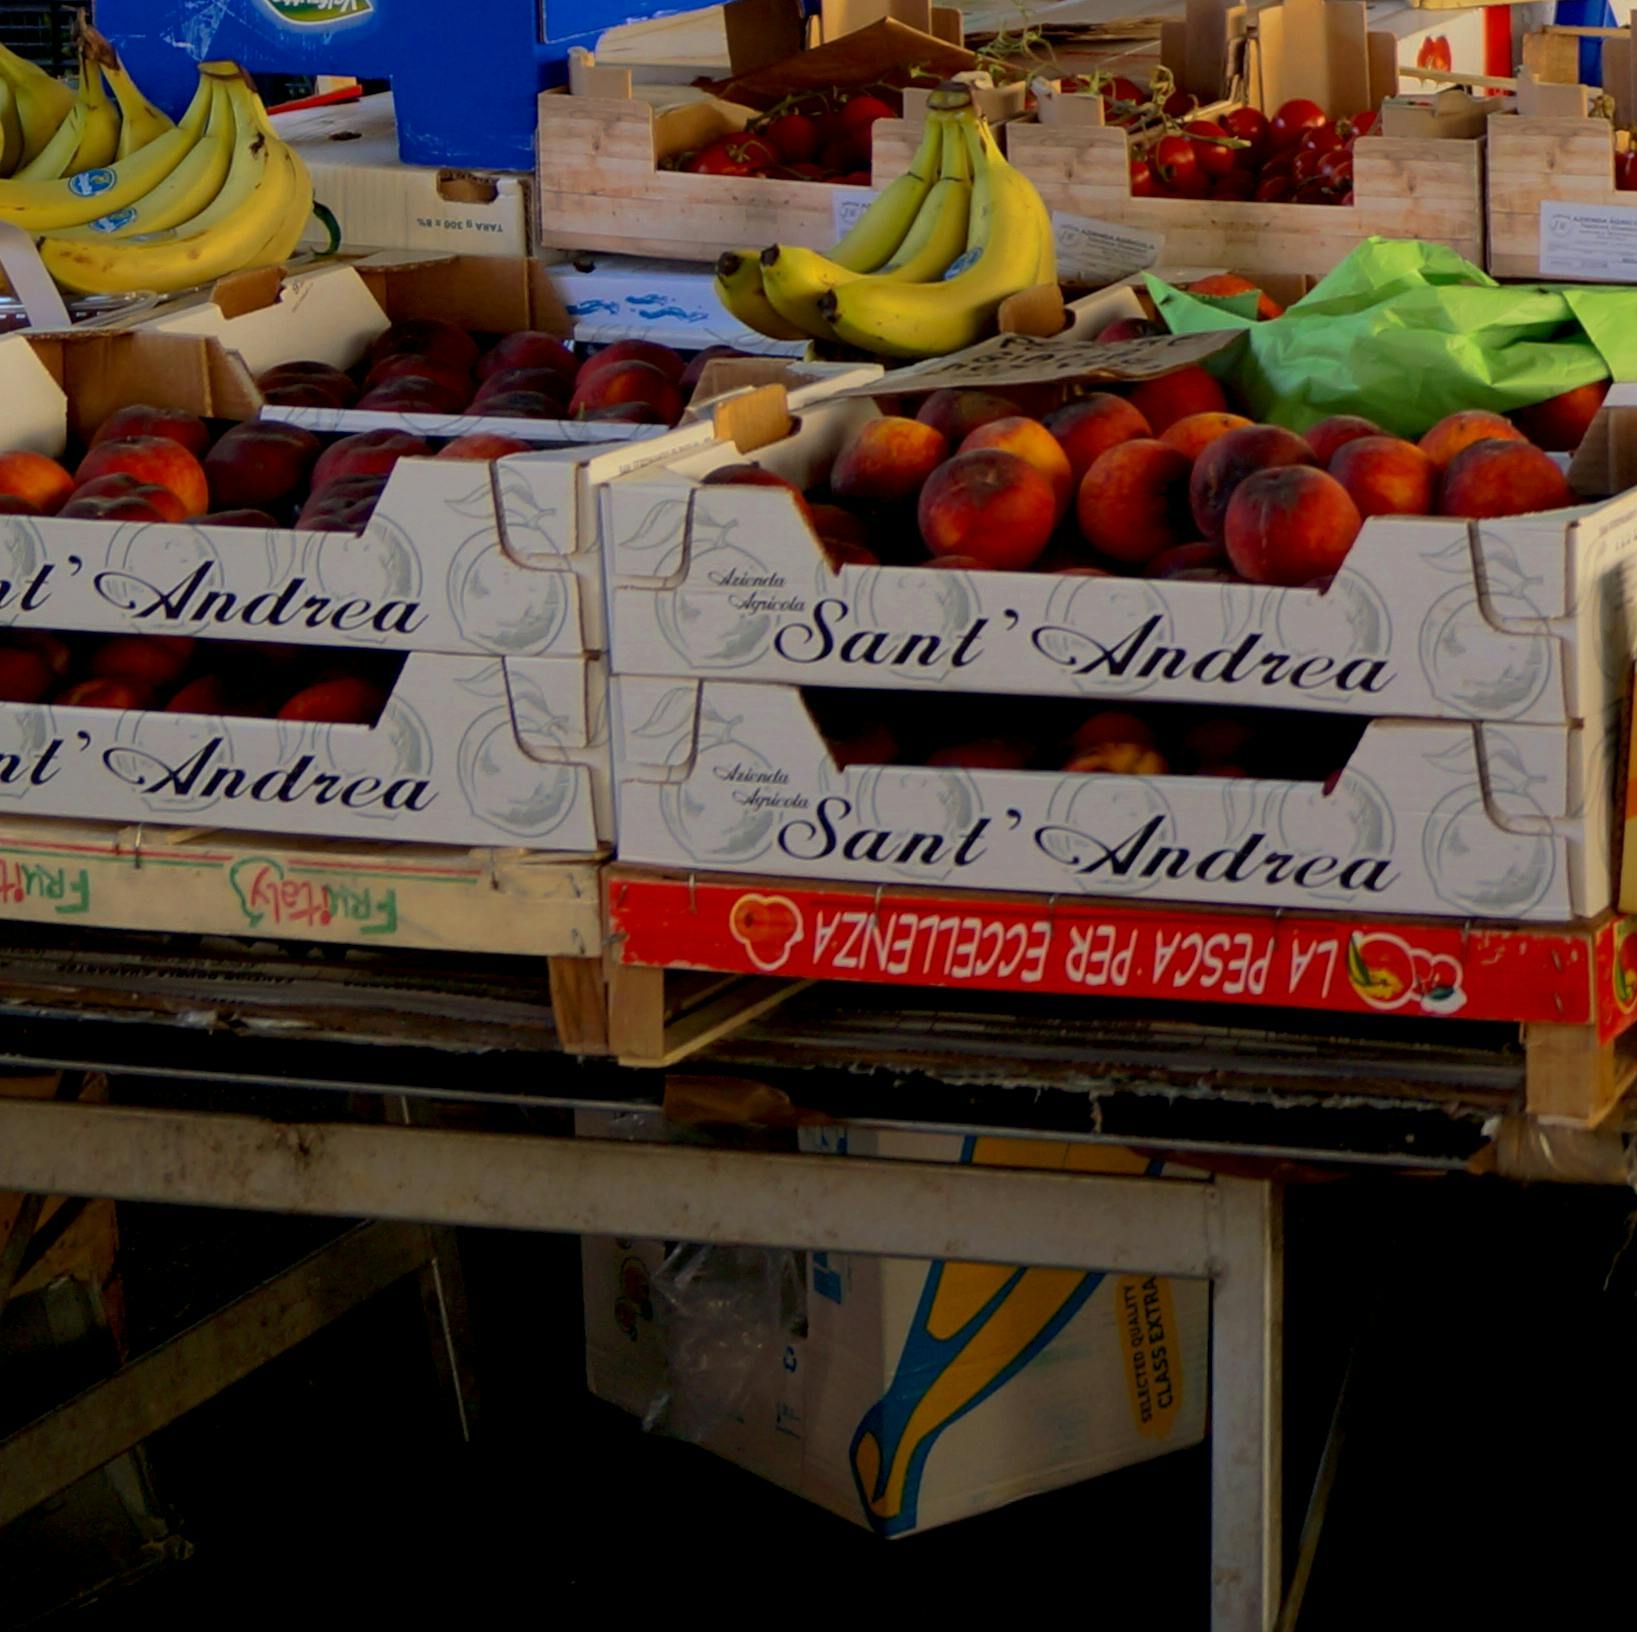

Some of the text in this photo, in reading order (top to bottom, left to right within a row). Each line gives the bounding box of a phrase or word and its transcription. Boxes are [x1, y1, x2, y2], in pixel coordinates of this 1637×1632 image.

[94, 560, 429, 634] Andrea
[708, 568, 786, 588] Azienda
[728, 591, 805, 615] Agricola
[1031, 614, 1398, 693] Andrea
[103, 737, 439, 811] Andrea
[713, 764, 790, 785] Azienda
[732, 787, 809, 810] Agricola
[1034, 814, 1400, 892] Andrea
[812, 911, 1339, 1000] LA PESCA PER ECCELLENZA
[1123, 1284, 1152, 1423] SELECTED QUALITY
[1142, 1275, 1173, 1409] CLASS EXTRA
